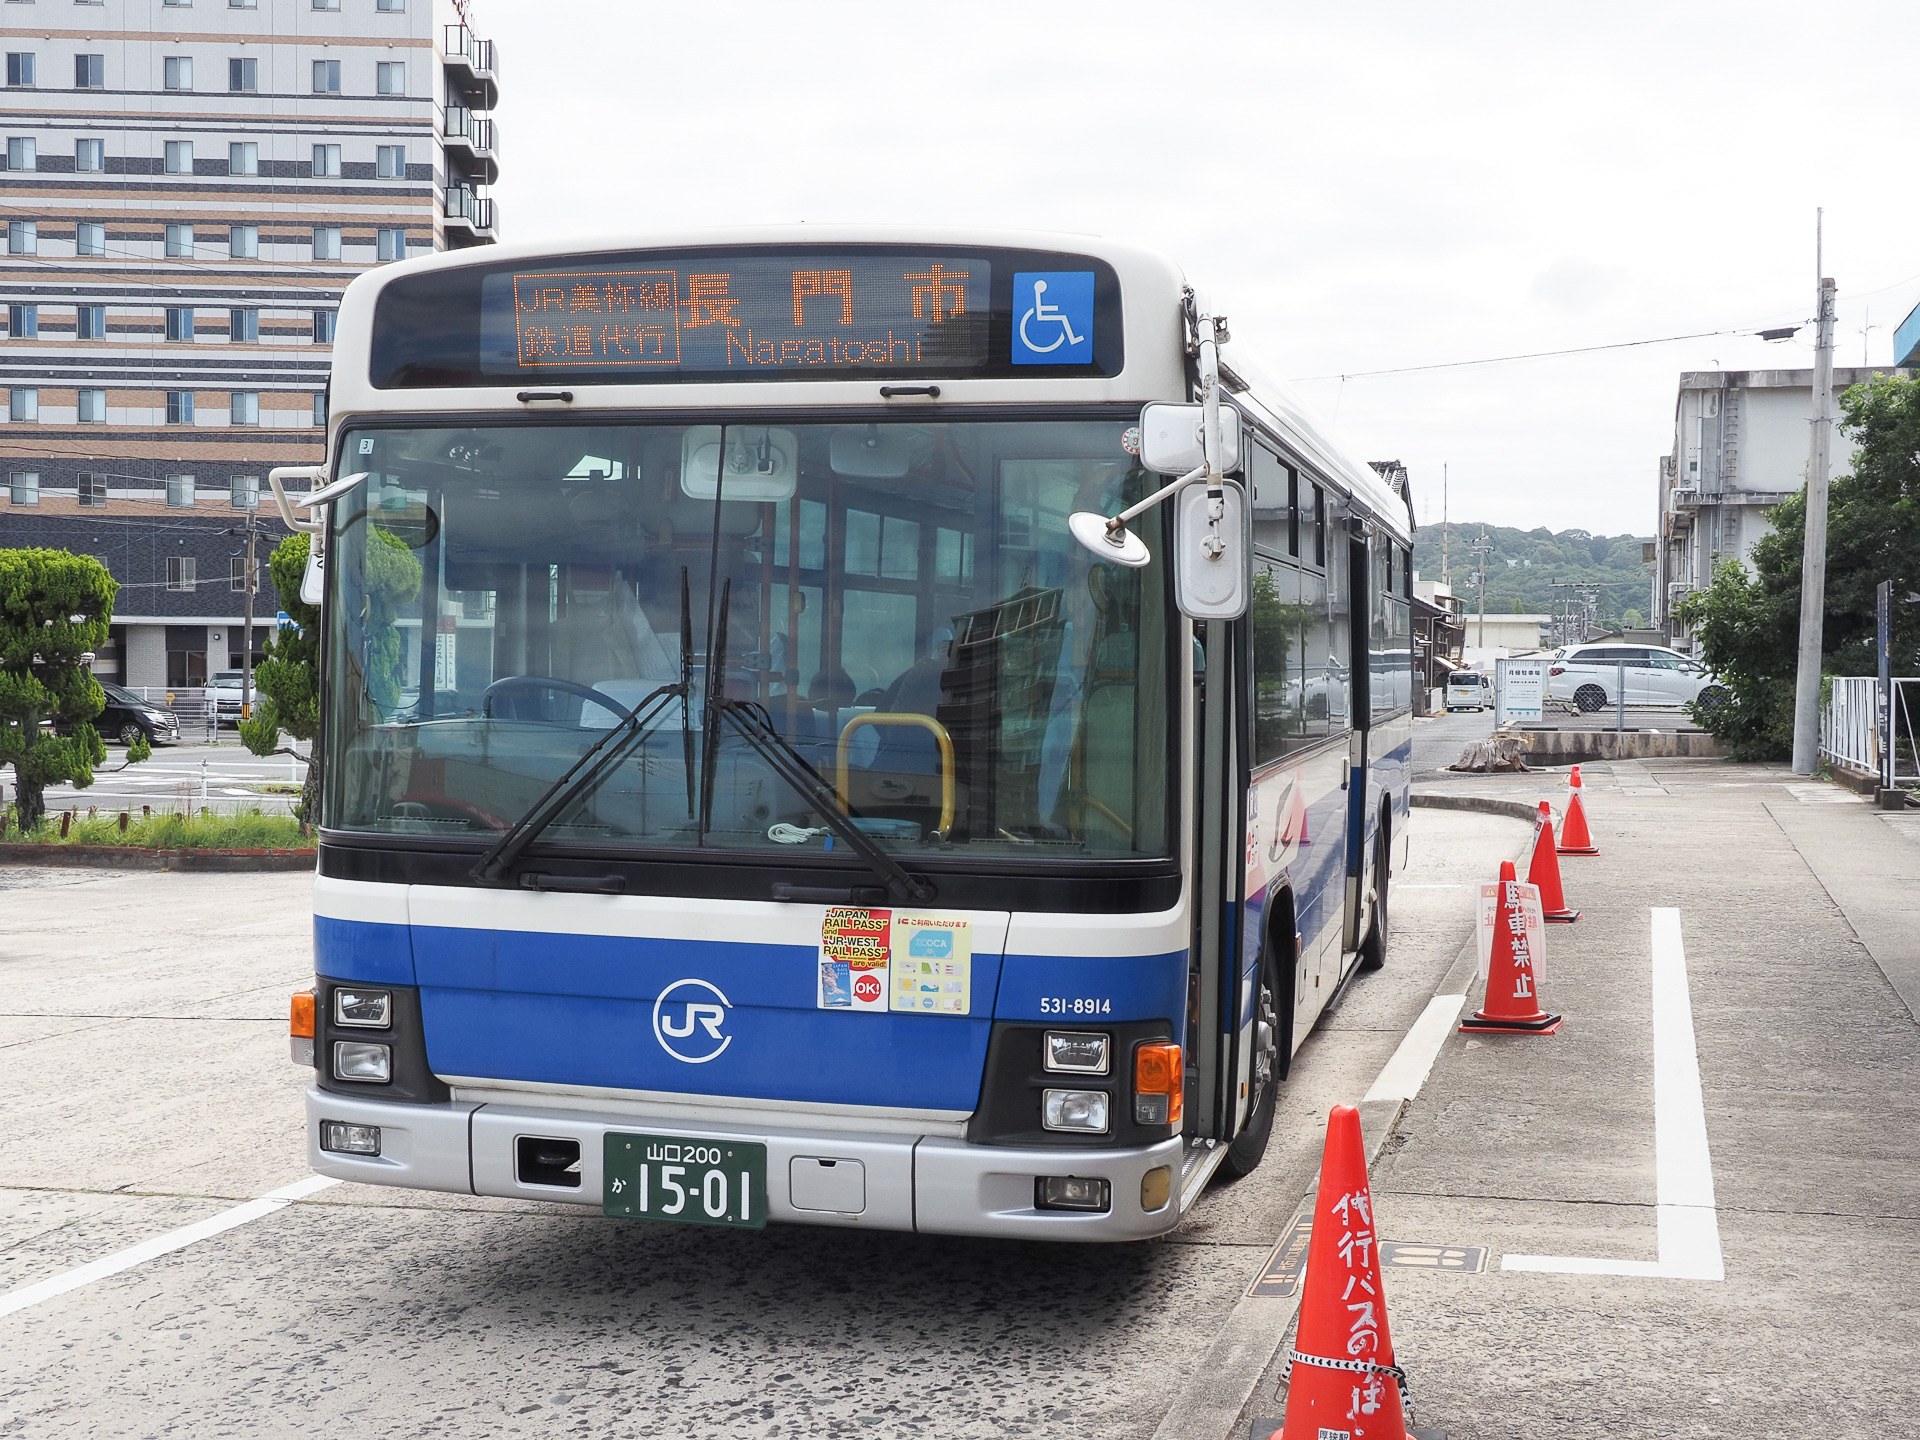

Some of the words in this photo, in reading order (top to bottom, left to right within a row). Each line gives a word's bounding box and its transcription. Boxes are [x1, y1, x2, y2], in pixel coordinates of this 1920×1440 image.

[520, 281, 673, 313] JR美祢線
[680, 264, 969, 328] 長門市
[525, 324, 667, 356] 鉄道代行
[727, 329, 921, 365] Nagatoshi
[824, 919, 850, 928] RAIL
[823, 946, 849, 956] RAIL
[915, 939, 947, 948] ICOCA
[856, 982, 880, 995] OK!
[661, 1003, 725, 1039] JR
[1040, 998, 1111, 1014] 531-8914
[611, 1178, 627, 1194] か
[639, 1163, 750, 1220] 15-01
